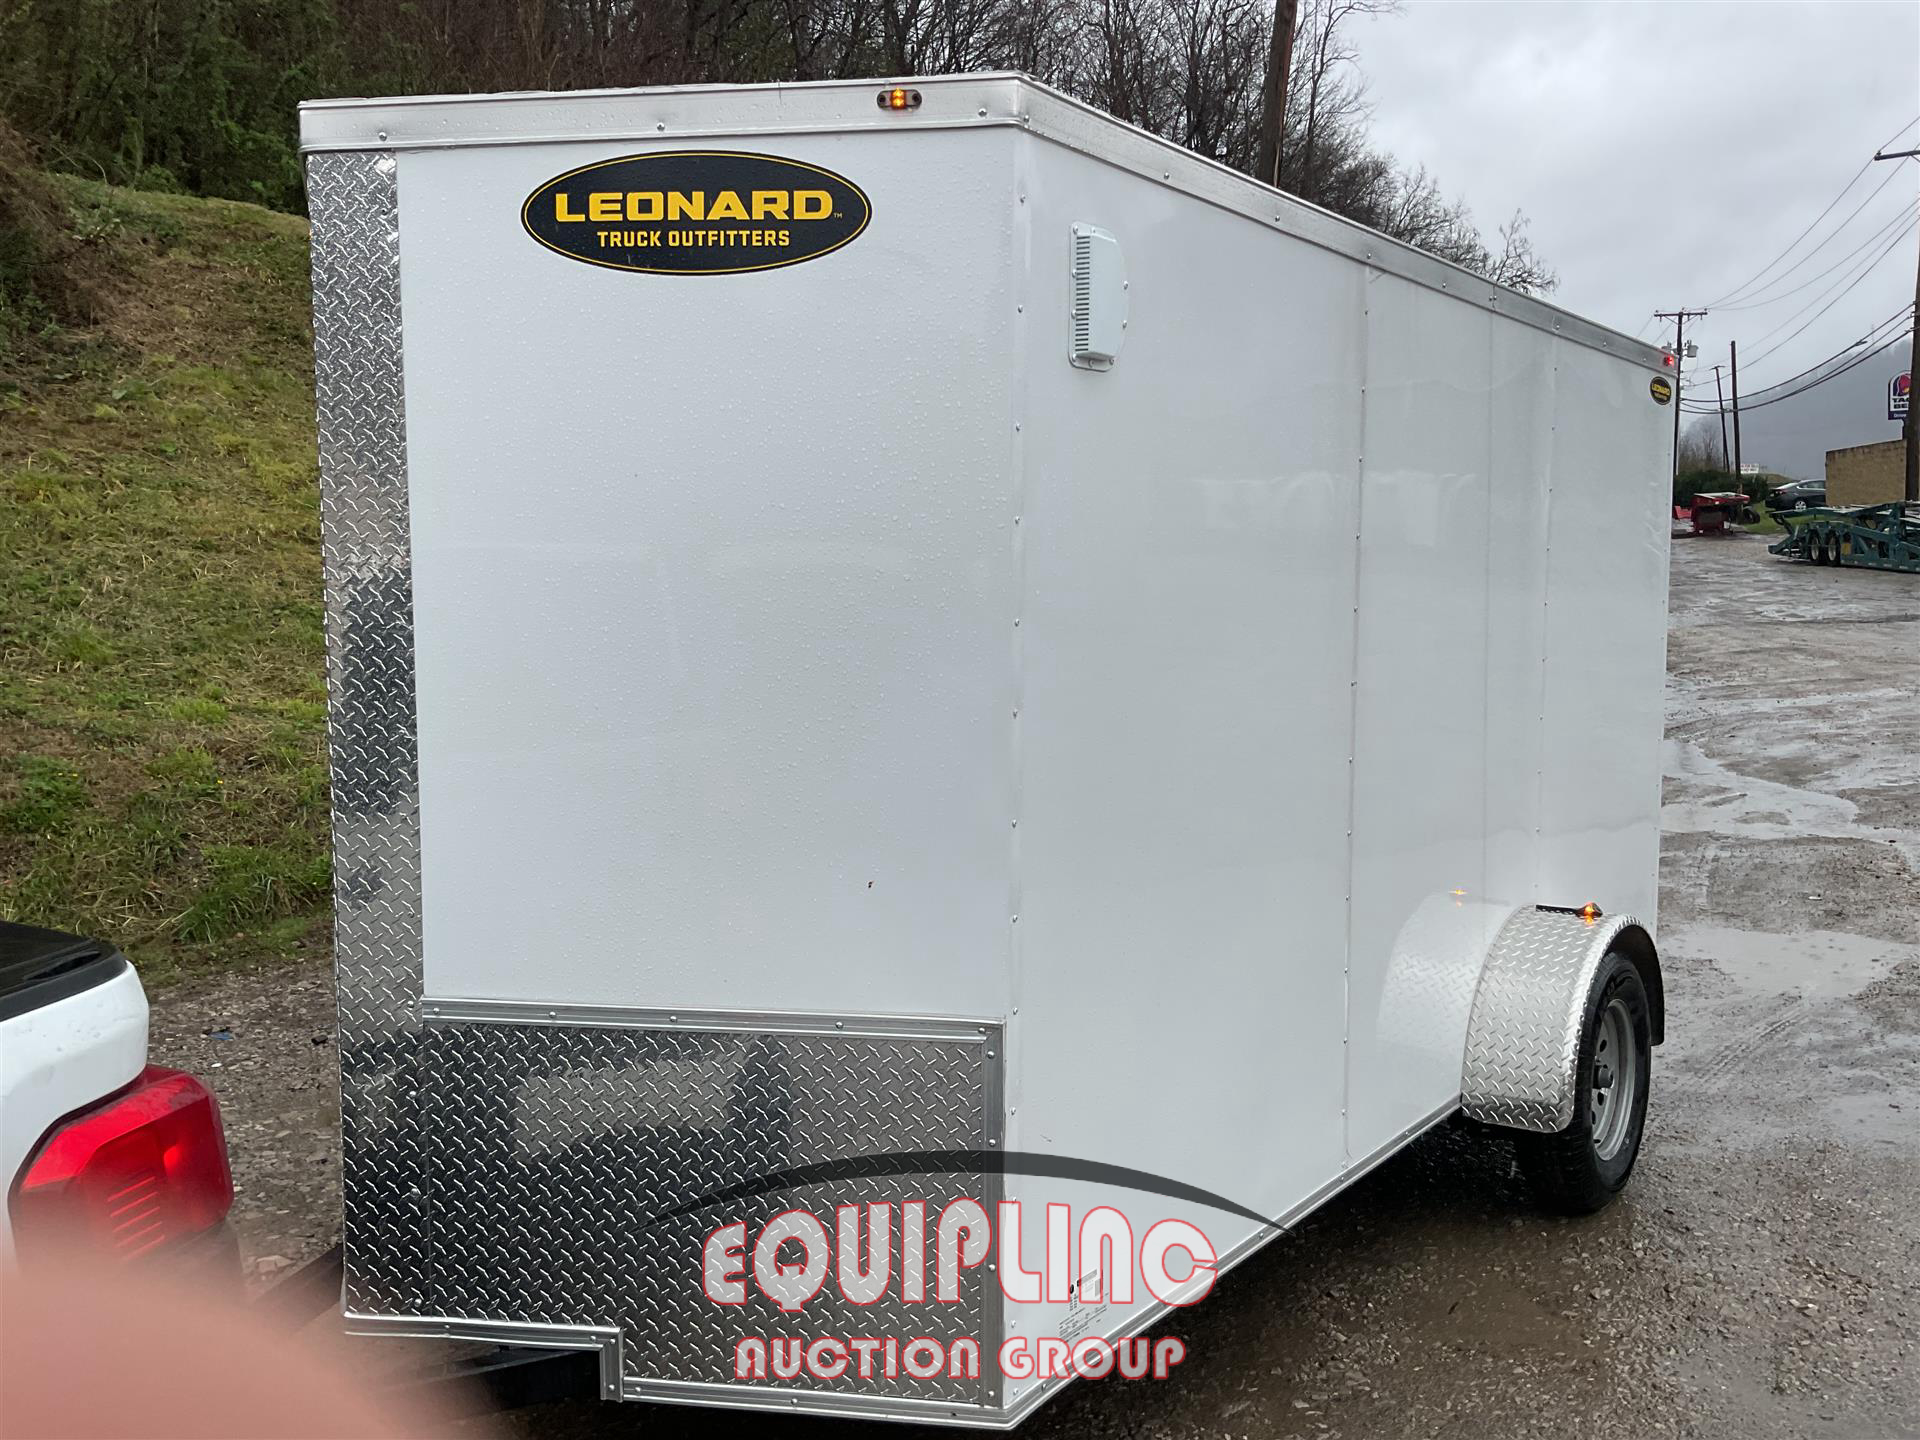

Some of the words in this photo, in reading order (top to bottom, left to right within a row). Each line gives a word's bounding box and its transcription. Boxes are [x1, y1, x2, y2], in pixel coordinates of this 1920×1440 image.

[555, 190, 833, 222] LEONARD
[597, 231, 662, 248] TRUCK
[668, 230, 790, 247] OUTFITTERS
